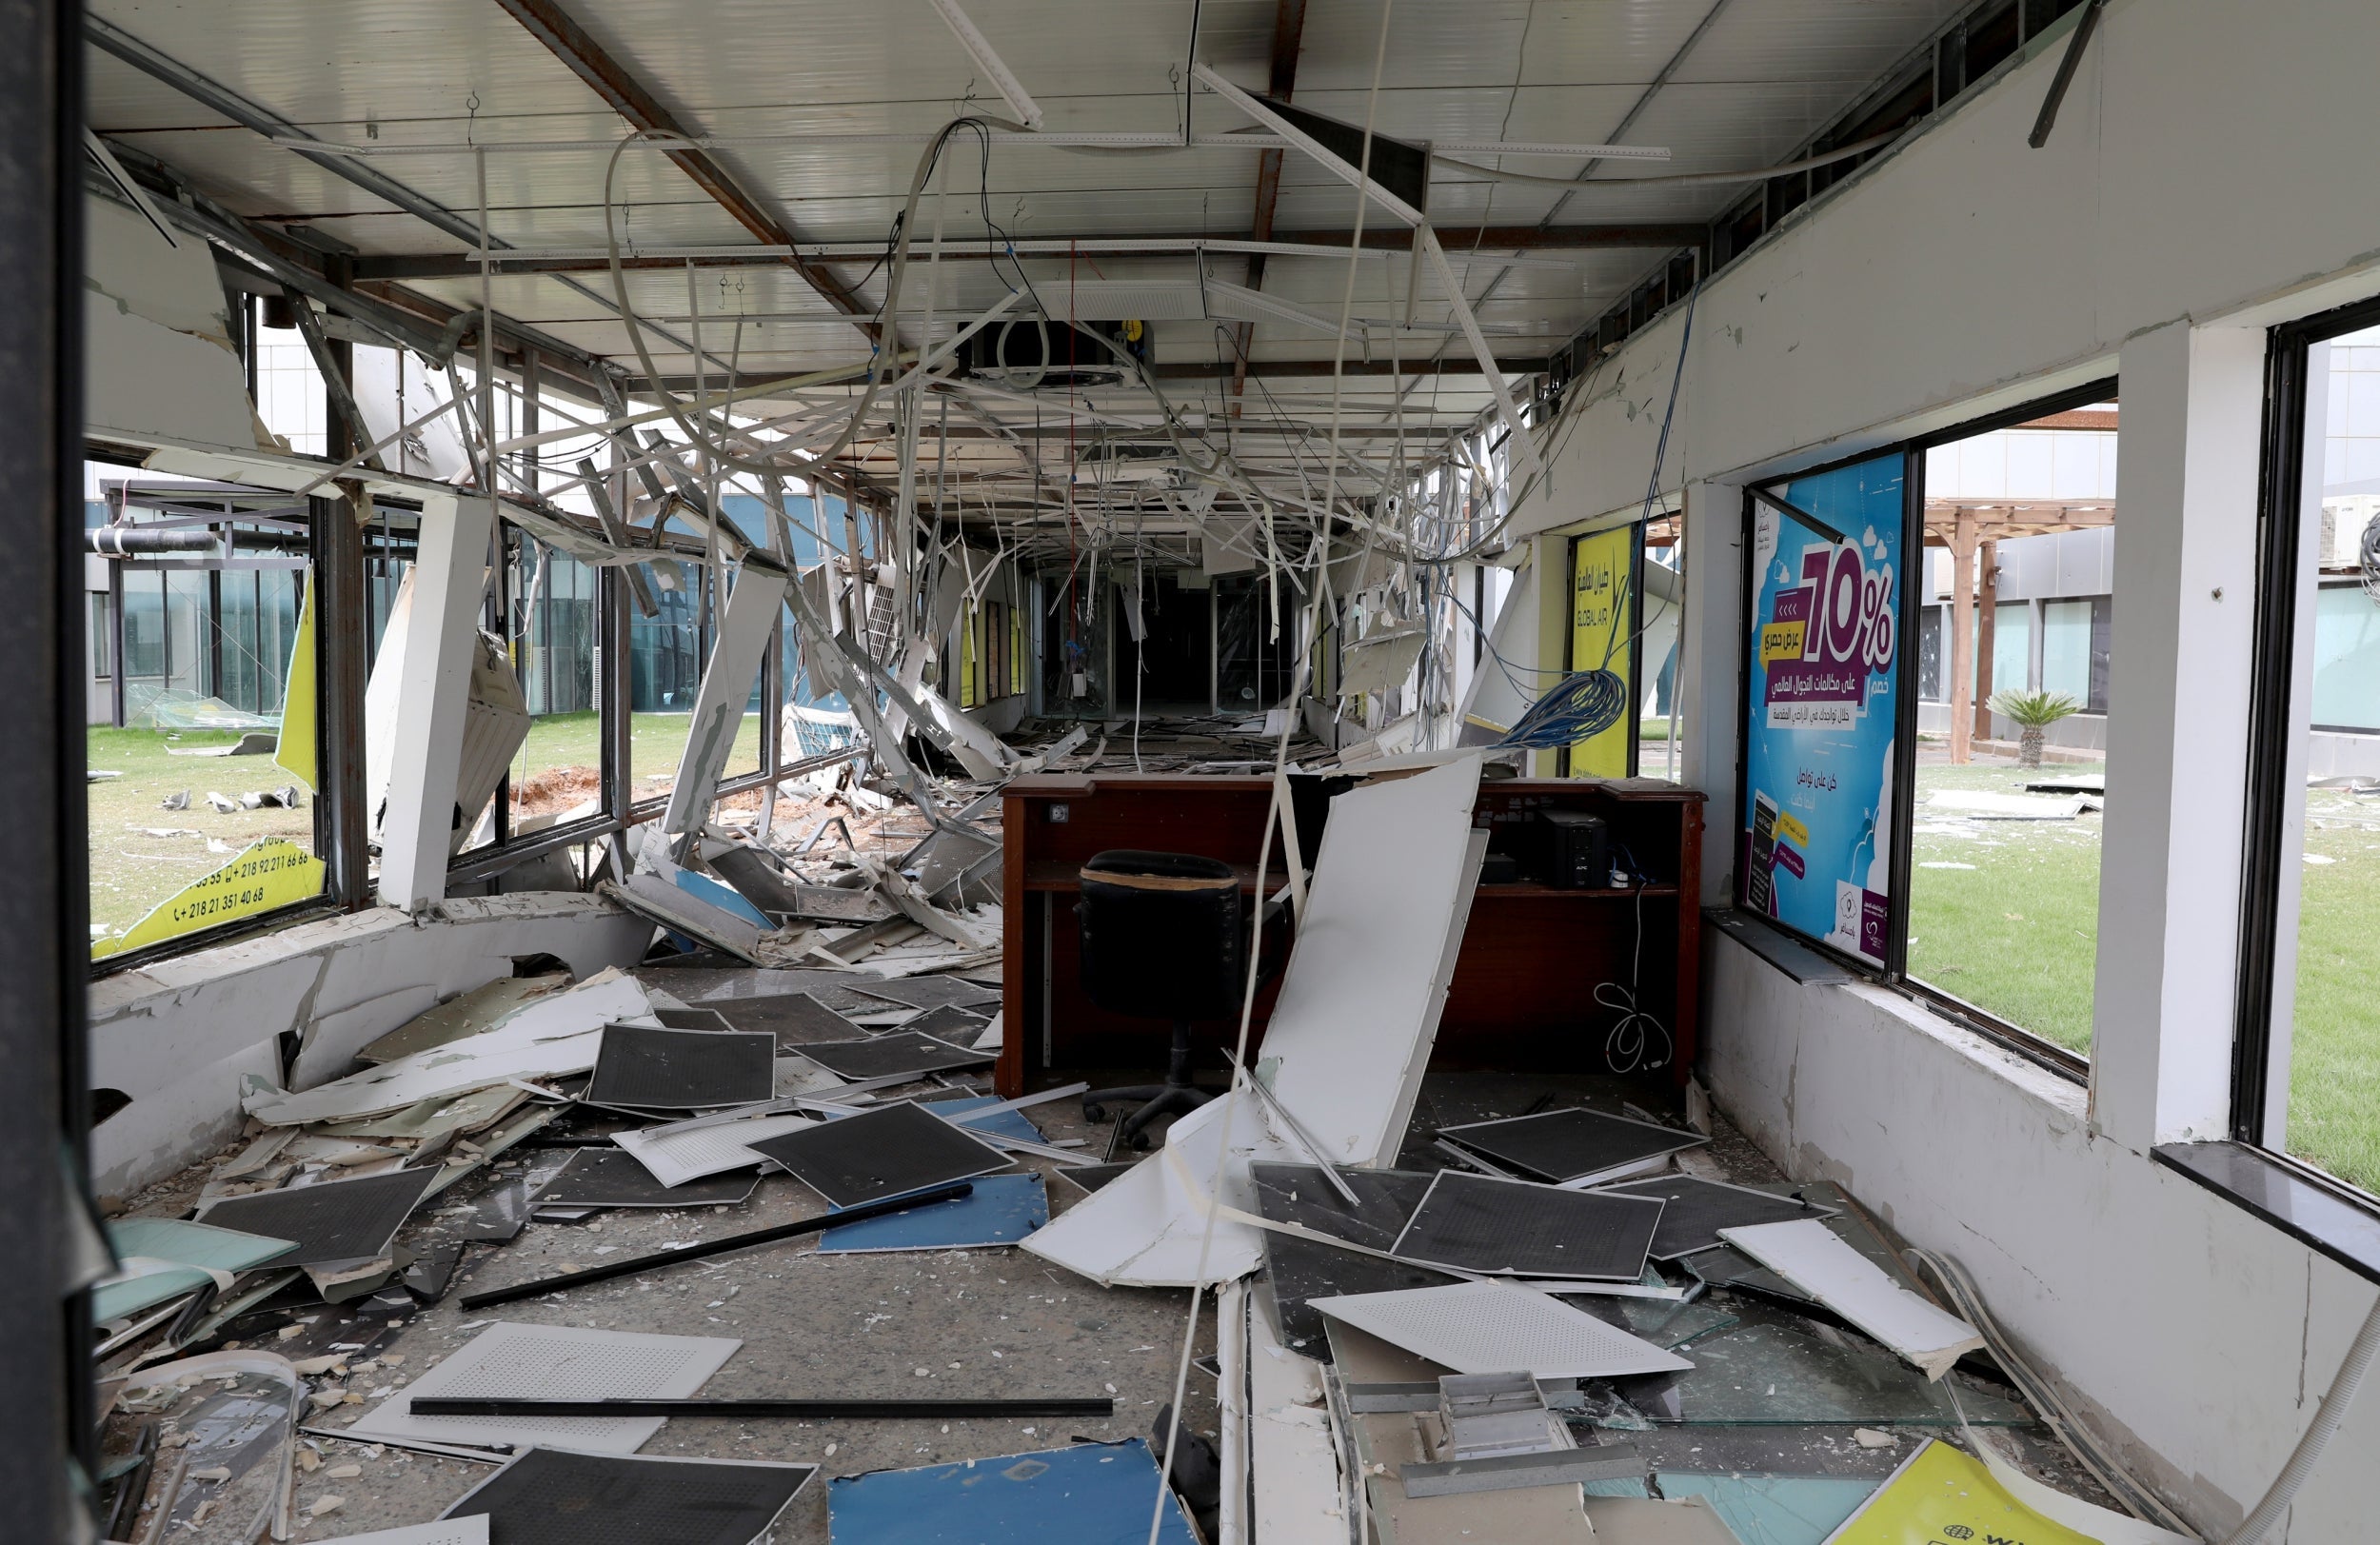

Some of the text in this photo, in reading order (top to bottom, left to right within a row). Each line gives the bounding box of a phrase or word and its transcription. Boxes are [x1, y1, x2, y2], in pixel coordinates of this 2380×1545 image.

[1595, 562, 1609, 595] طيران
[1577, 607, 1608, 627] GLOBAL AIR
[1764, 628, 1799, 656] عرض حصري
[1771, 672, 1855, 699] على مكالمات التجوال العالمي
[1871, 676, 1889, 697] خصم
[1773, 707, 1792, 721] المقدسة
[1809, 707, 1818, 726] في
[1837, 707, 1850, 723] خلال
[1796, 765, 1837, 792] كن على تواصل
[241, 861, 257, 879] 218
[259, 859, 269, 874] 92
[270, 855, 285, 871] 211
[287, 853, 297, 867] 66
[298, 851, 308, 865] 66
[188, 901, 207, 919] 218
[208, 898, 220, 914] 21
[222, 893, 238, 910] 351
[240, 890, 251, 905] 40
[252, 887, 264, 902] 68
